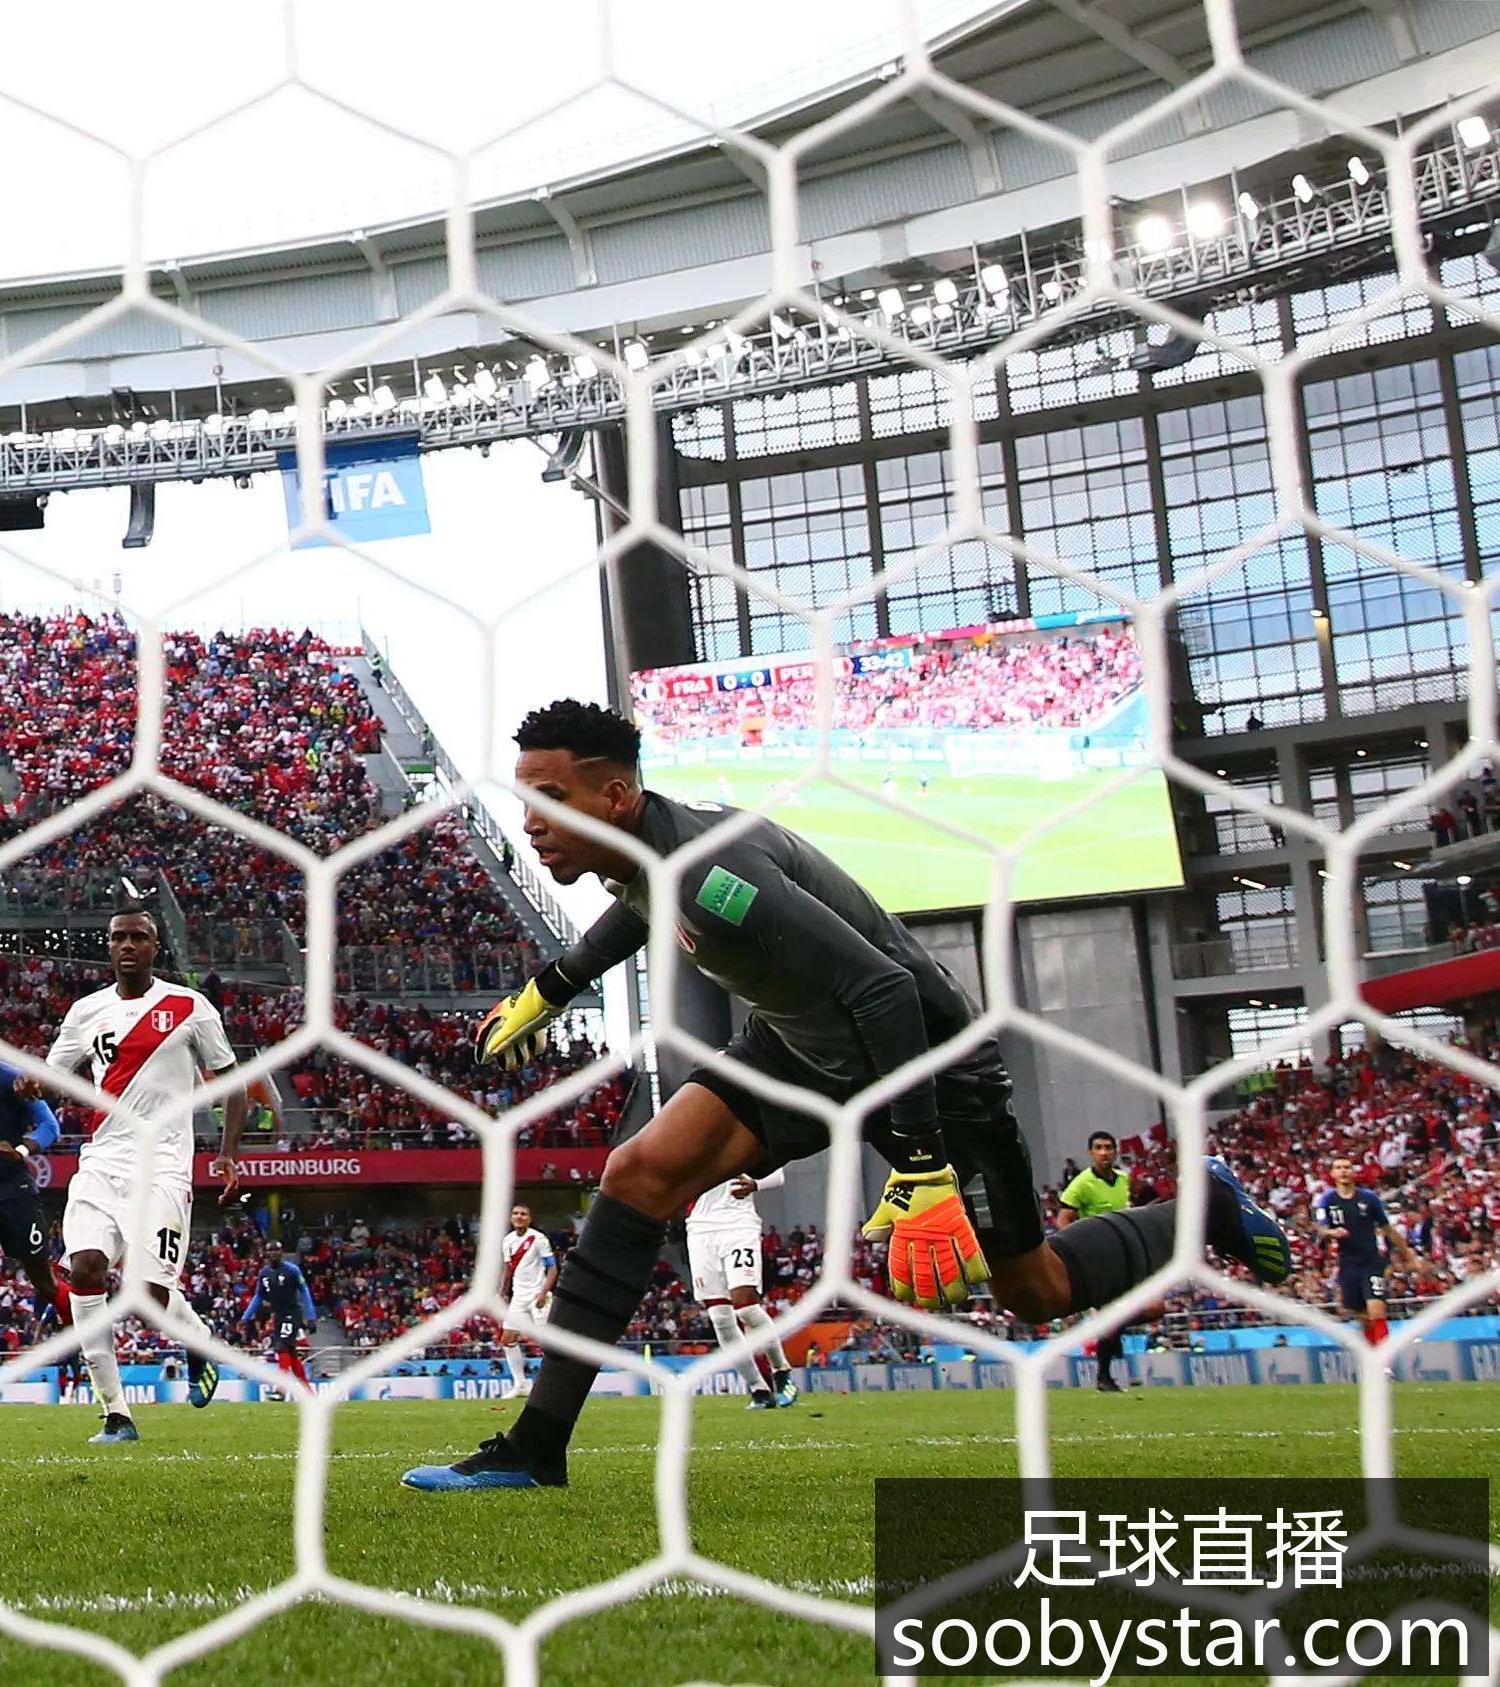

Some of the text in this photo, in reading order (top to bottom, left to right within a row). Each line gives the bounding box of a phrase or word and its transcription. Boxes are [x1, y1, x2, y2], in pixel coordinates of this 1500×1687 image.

[312, 471, 407, 513] IFA
[672, 680, 709, 694] FRA
[92, 1031, 119, 1066] 15
[208, 1158, 361, 1177] EATERINBURG
[29, 1223, 43, 1246] 6
[156, 1227, 182, 1264] 15
[731, 1247, 755, 1269] 23
